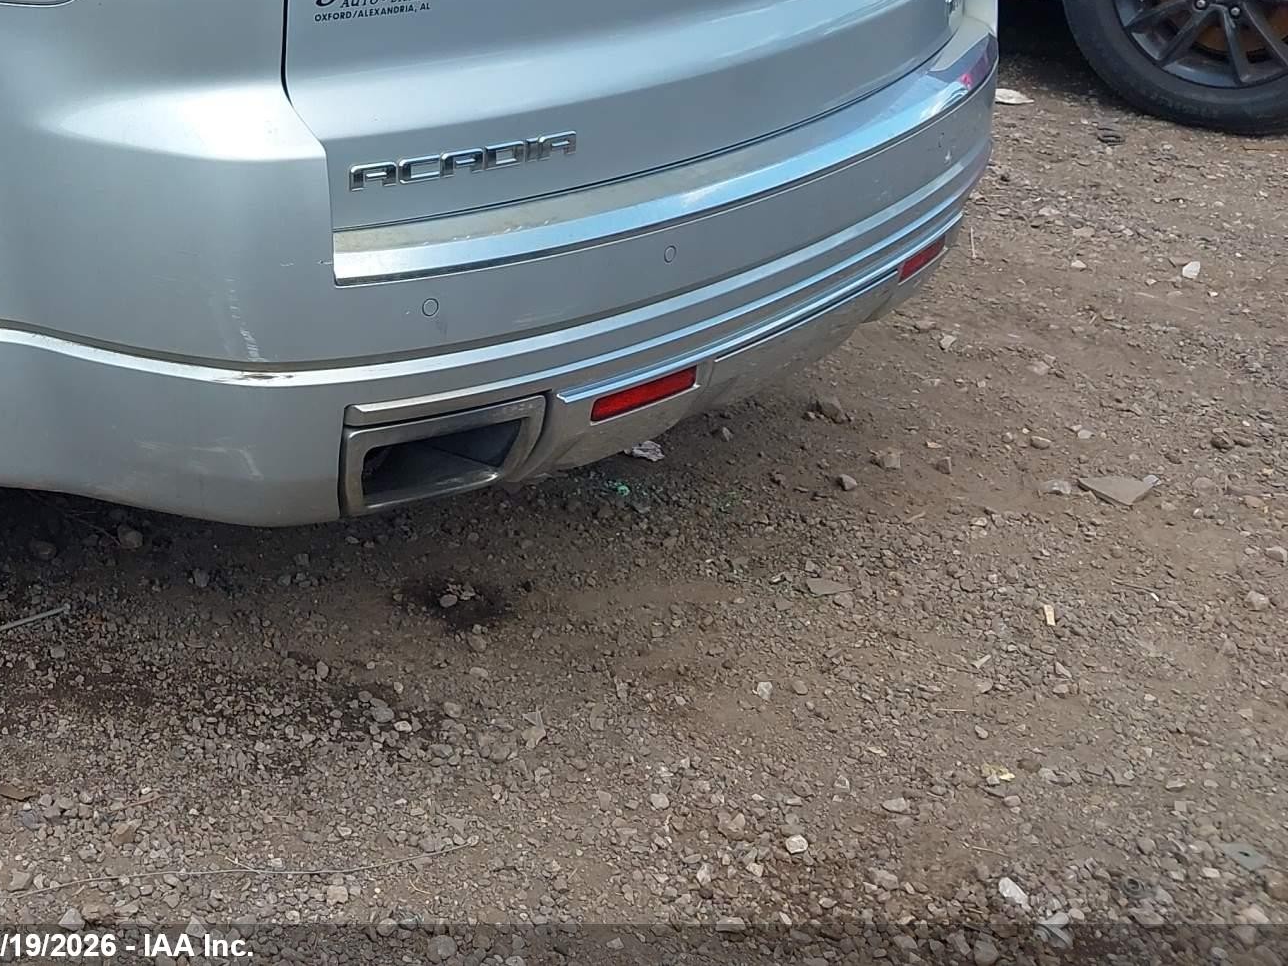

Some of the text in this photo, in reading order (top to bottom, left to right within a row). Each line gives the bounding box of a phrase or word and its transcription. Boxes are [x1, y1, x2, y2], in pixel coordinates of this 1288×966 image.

[314, 2, 431, 22] OXFORD/ALEXANDRIA, AL
[349, 130, 577, 192] ACADIA
